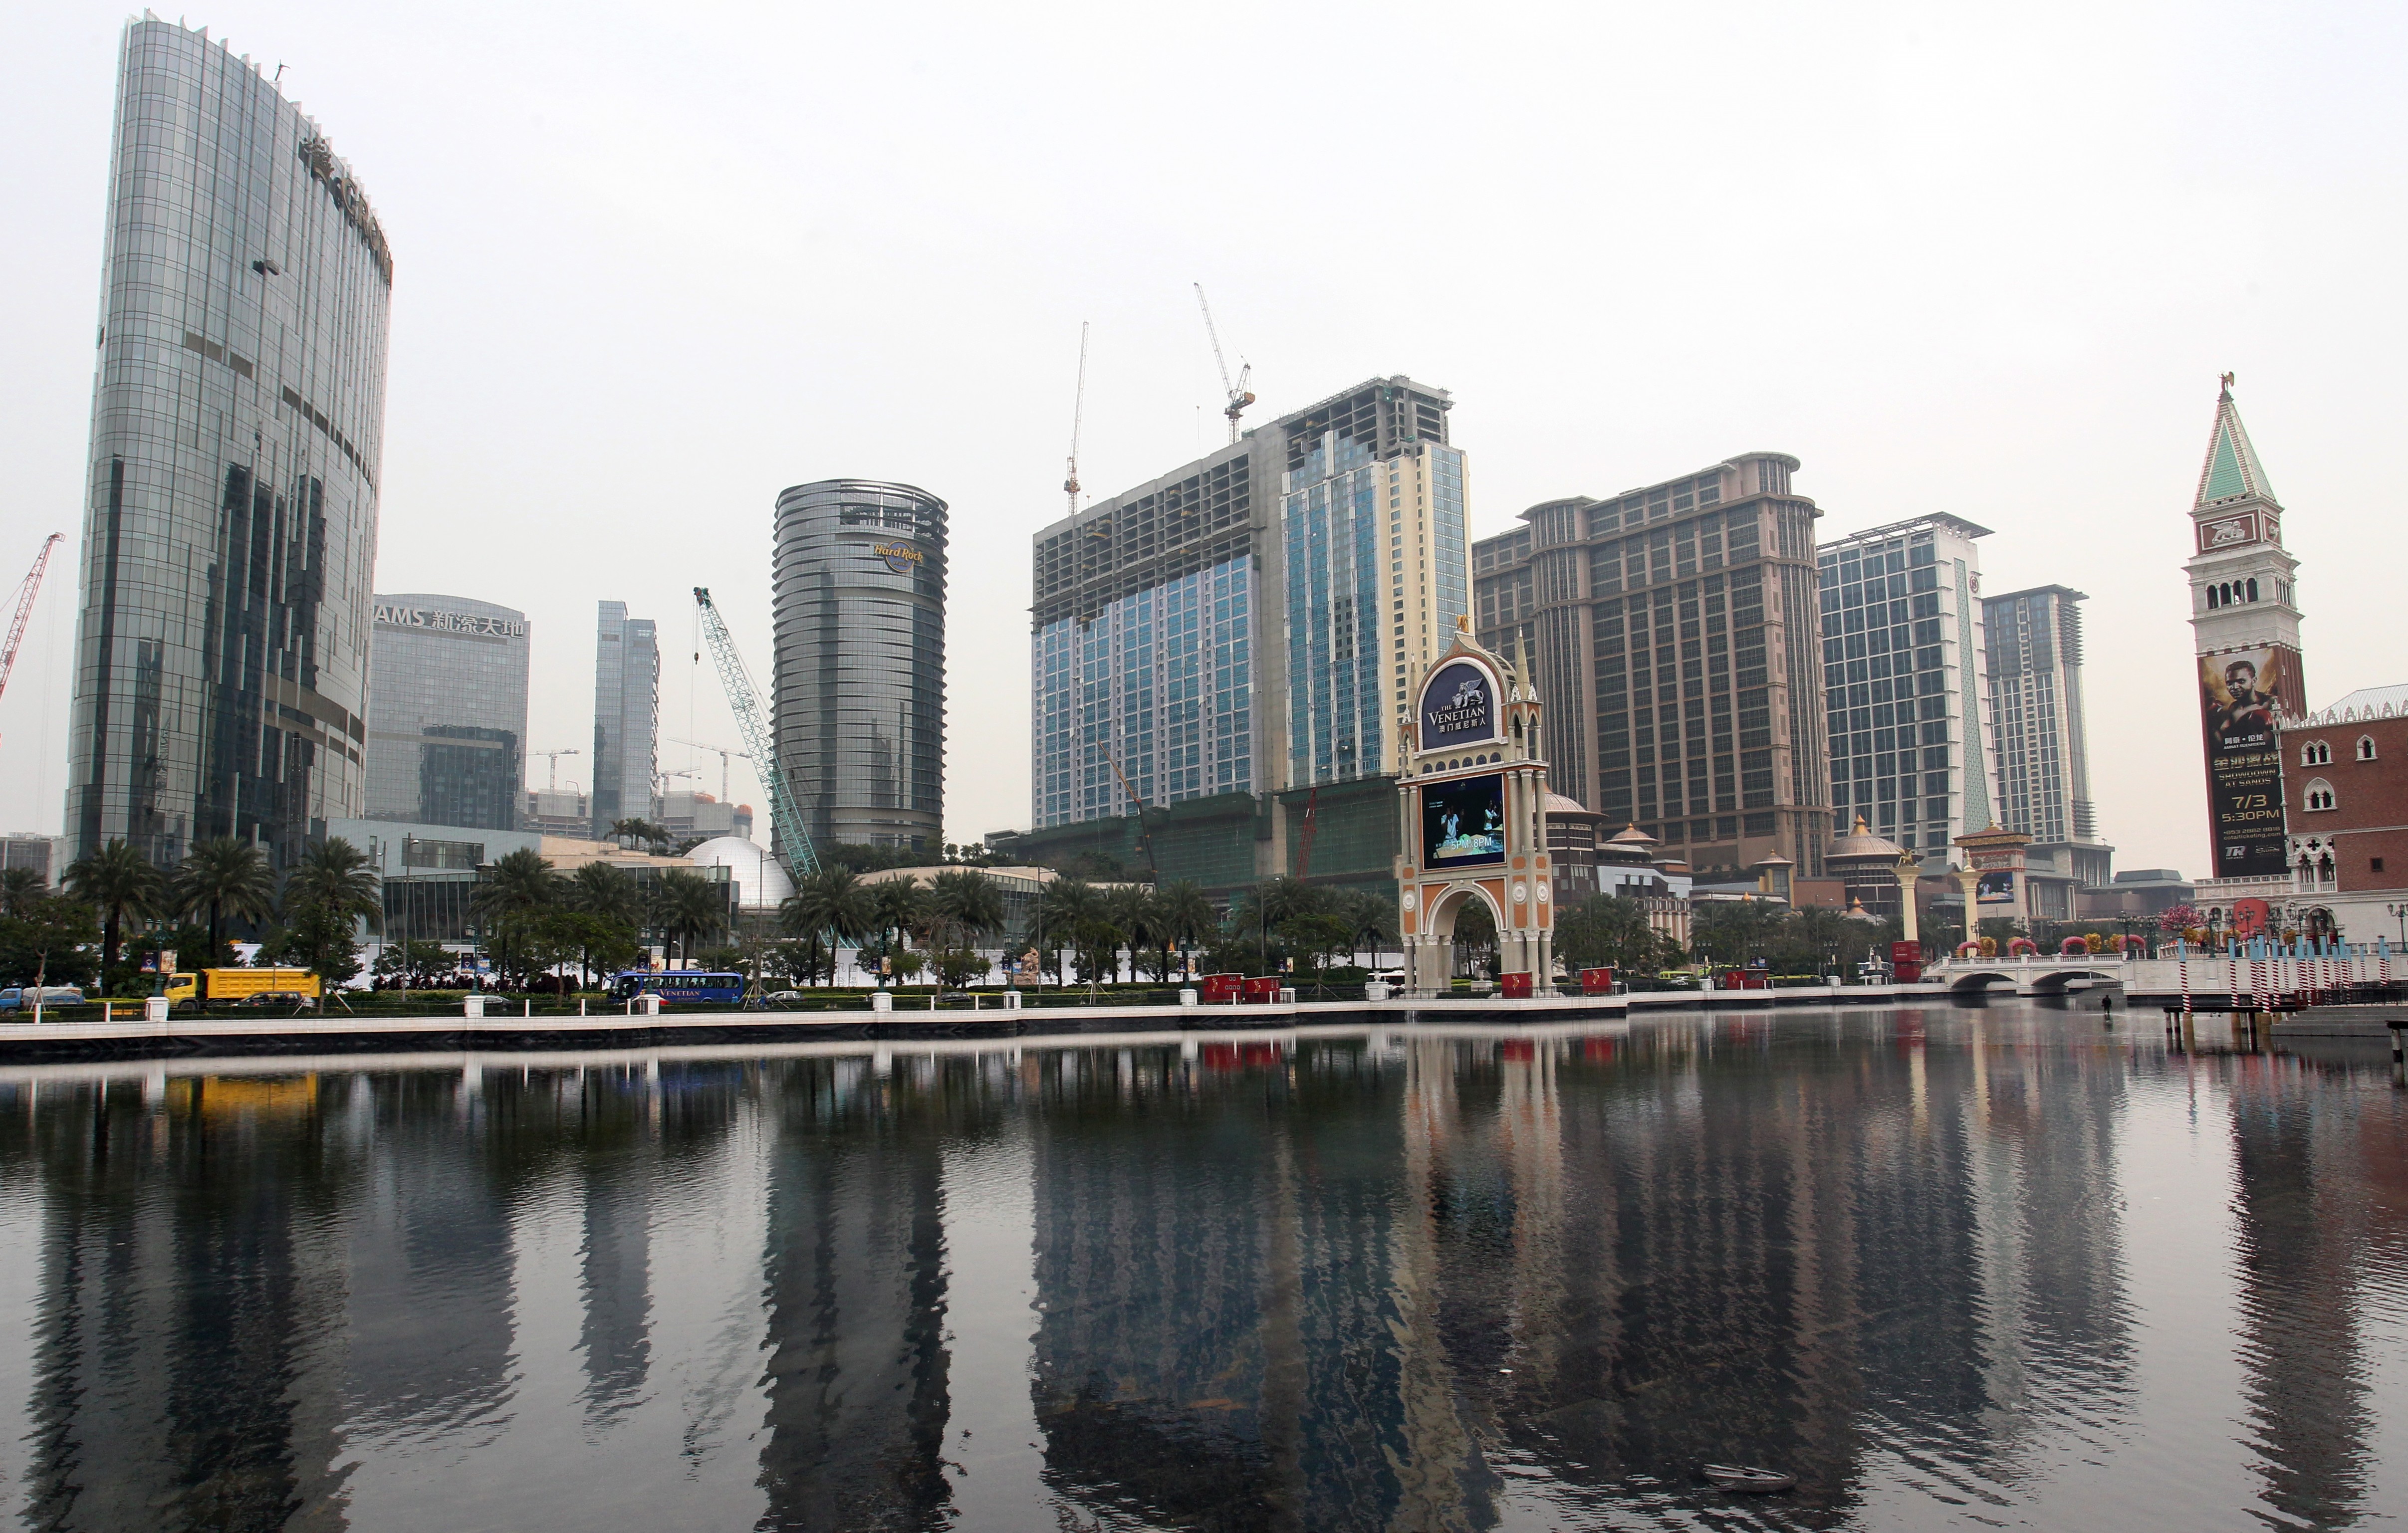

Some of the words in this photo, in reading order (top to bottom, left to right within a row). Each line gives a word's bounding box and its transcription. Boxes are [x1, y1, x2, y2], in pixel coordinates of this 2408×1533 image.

[874, 544, 900, 557] Hard
[901, 548, 923, 563] Rock
[432, 610, 523, 639] 新濠天地
[1428, 705, 1485, 726] VENETIAN
[2219, 769, 2276, 780] SHOWDOWN
[2239, 778, 2271, 787] SANDS
[2231, 794, 2267, 809] 7/3
[2222, 809, 2279, 822] 5:30PM
[2223, 832, 2281, 841] cotaiticketing.com
[1451, 840, 1469, 850] 5PM
[1473, 837, 1492, 847] 8PM
